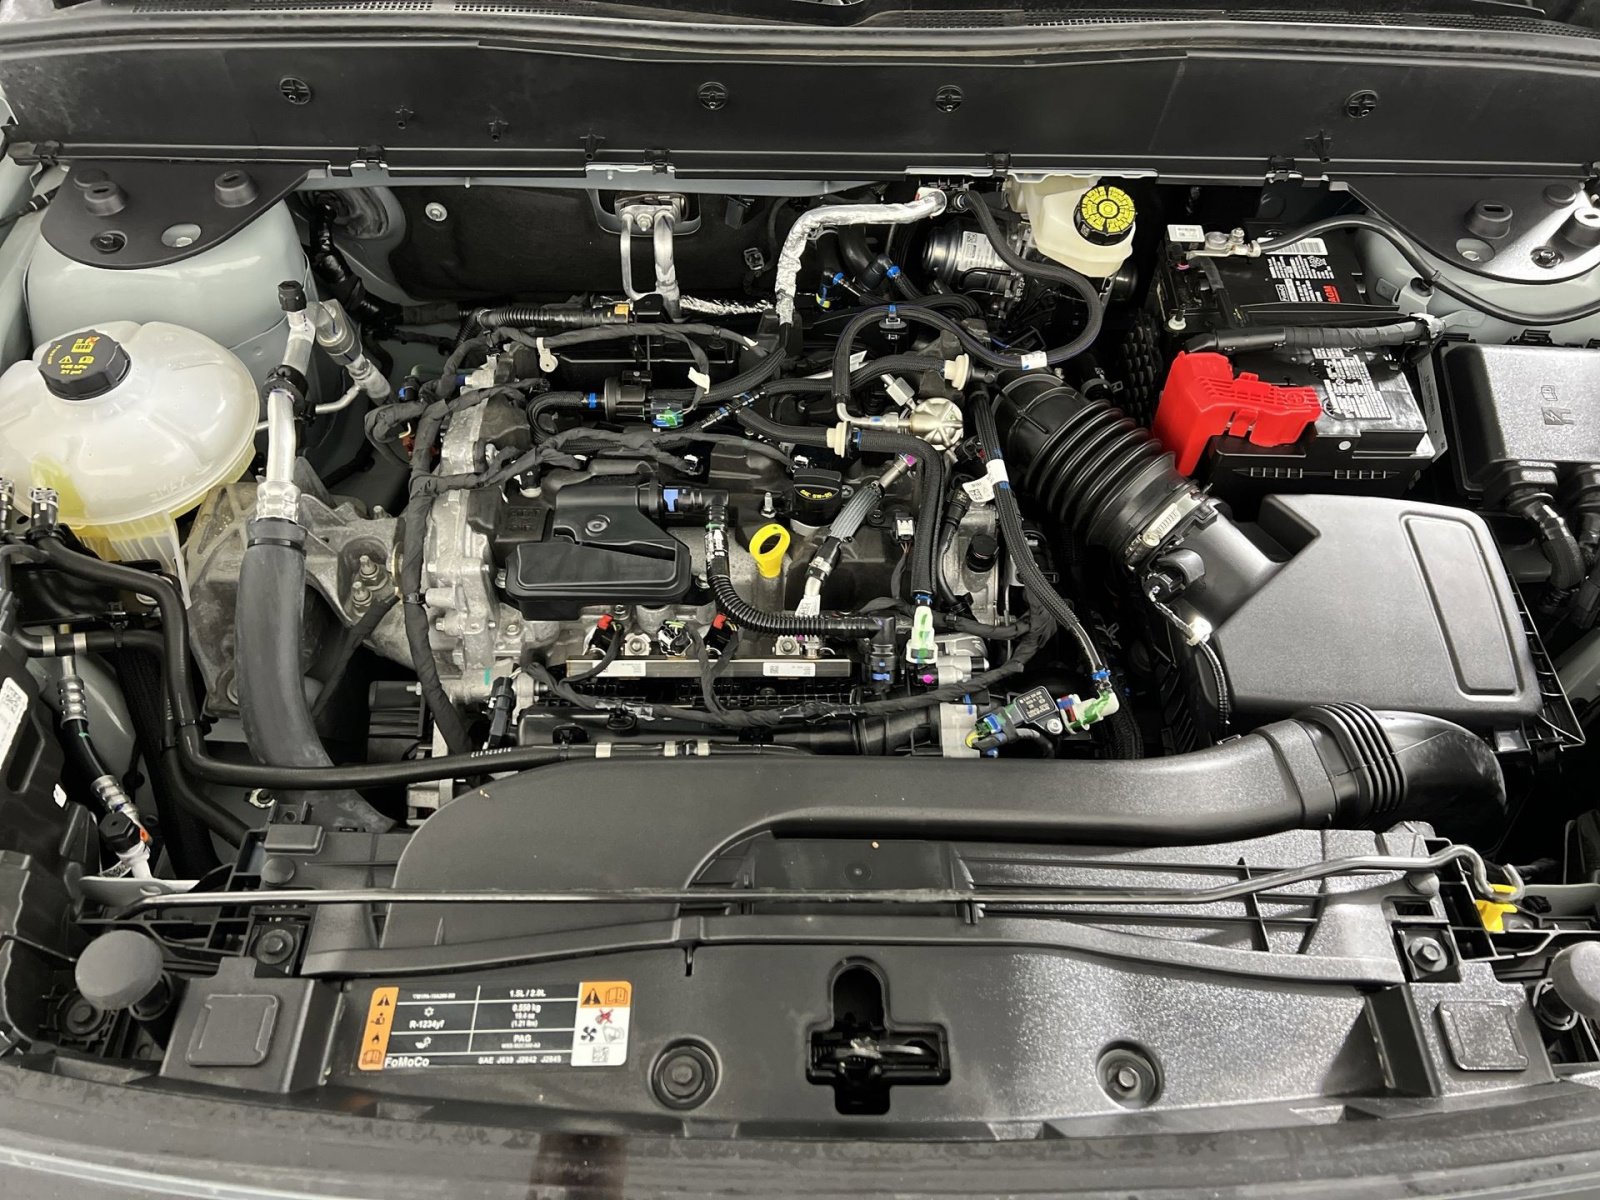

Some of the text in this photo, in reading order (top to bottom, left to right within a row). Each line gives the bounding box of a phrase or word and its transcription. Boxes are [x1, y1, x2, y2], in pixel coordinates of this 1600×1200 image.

[409, 1019, 445, 1030] R-1234yf
[513, 1034, 532, 1043] PAG
[384, 1056, 430, 1068] FoMoCo
[478, 1056, 494, 1064] SAE
